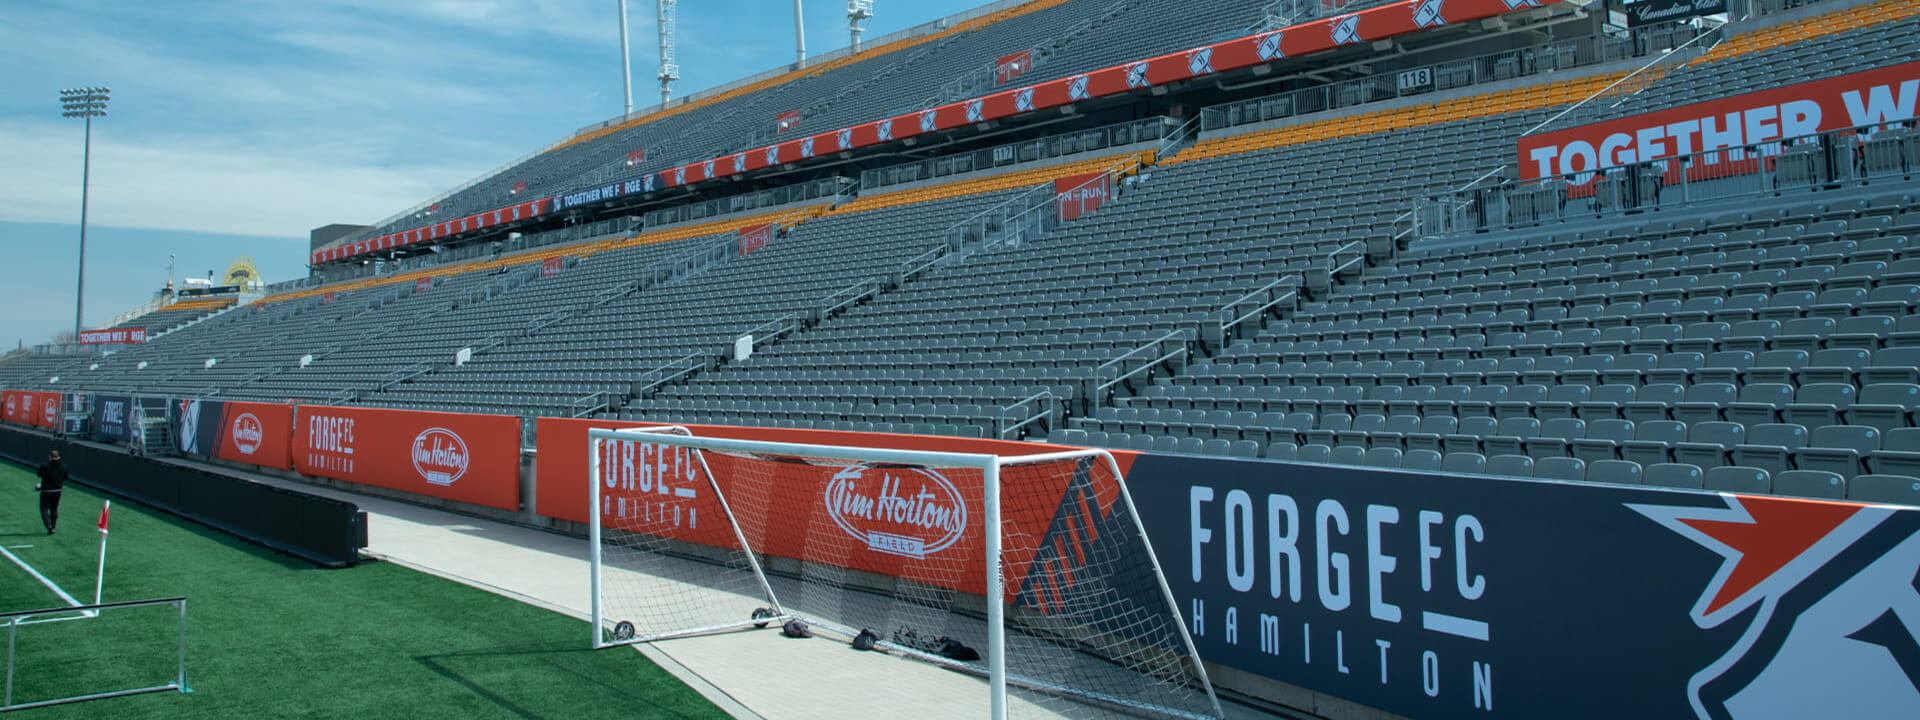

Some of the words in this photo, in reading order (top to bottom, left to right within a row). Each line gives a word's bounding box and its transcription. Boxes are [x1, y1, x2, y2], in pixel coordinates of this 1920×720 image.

[1636, 2, 1692, 21] Canadian
[1402, 70, 1426, 88] 118
[995, 147, 1011, 160] 117
[1530, 98, 1823, 188] TOGETHER
[564, 188, 601, 208] TOGETHER
[601, 185, 614, 200] WE
[81, 332, 111, 343] TOGETHER
[309, 415, 343, 453] FORGE
[344, 418, 355, 443] FC
[414, 435, 432, 465] Tim
[431, 436, 467, 469] Hortons
[832, 472, 874, 520] Tim
[876, 472, 961, 533] Hortons
[878, 537, 916, 552] FIELD
[1190, 485, 1402, 623] FORGE
[1418, 510, 1486, 600] FC
[1191, 597, 1493, 712] HAMILTON
